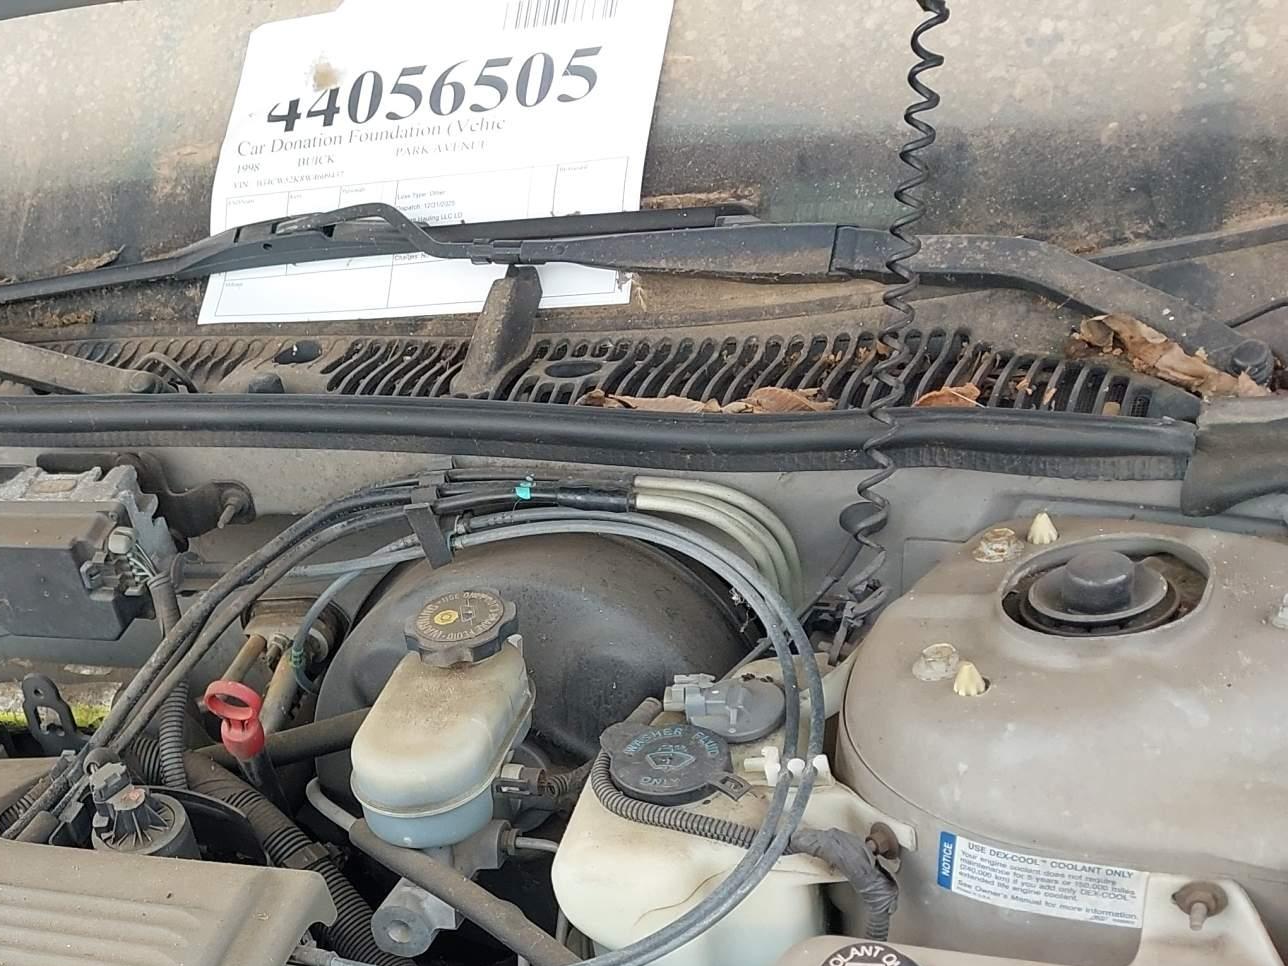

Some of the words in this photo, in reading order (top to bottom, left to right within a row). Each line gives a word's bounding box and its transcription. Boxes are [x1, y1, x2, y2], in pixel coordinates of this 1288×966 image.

[267, 45, 603, 133] 44056505
[237, 139, 267, 157] Car
[272, 132, 344, 153] Donation
[349, 122, 442, 144] Foundation
[237, 162, 261, 174] 1998
[297, 154, 335, 167] BUICK
[396, 144, 429, 158] PARK
[418, 214, 440, 224] Hauling
[441, 213, 453, 221] LLC
[623, 727, 683, 756] WASHER
[695, 731, 720, 758] FLUID
[640, 776, 681, 786] ONLY
[941, 841, 953, 877] NOTICE
[962, 851, 978, 860] Your
[980, 857, 1008, 869] engine
[1010, 864, 1041, 876] coolant
[1043, 869, 1065, 879] does
[1068, 873, 1082, 881] not
[1085, 876, 1116, 887] require
[968, 842, 986, 855] USE
[1050, 860, 1103, 876] COOLANT
[1105, 869, 1134, 879] ONLY
[959, 871, 994, 887] extended
[1012, 885, 1041, 897] engine
[960, 858, 1010, 876] maintenance
[1013, 871, 1024, 880] for
[1035, 876, 1058, 887] years
[1112, 887, 1136, 895] miles
[1020, 881, 1037, 891] you
[1039, 883, 1056, 892] add
[1059, 886, 1077, 897] only
[958, 880, 972, 889] See
[975, 885, 1008, 900] Owner's
[1011, 894, 1042, 906] Manual
[1045, 900, 1056, 909] for
[1060, 904, 1082, 912] more
